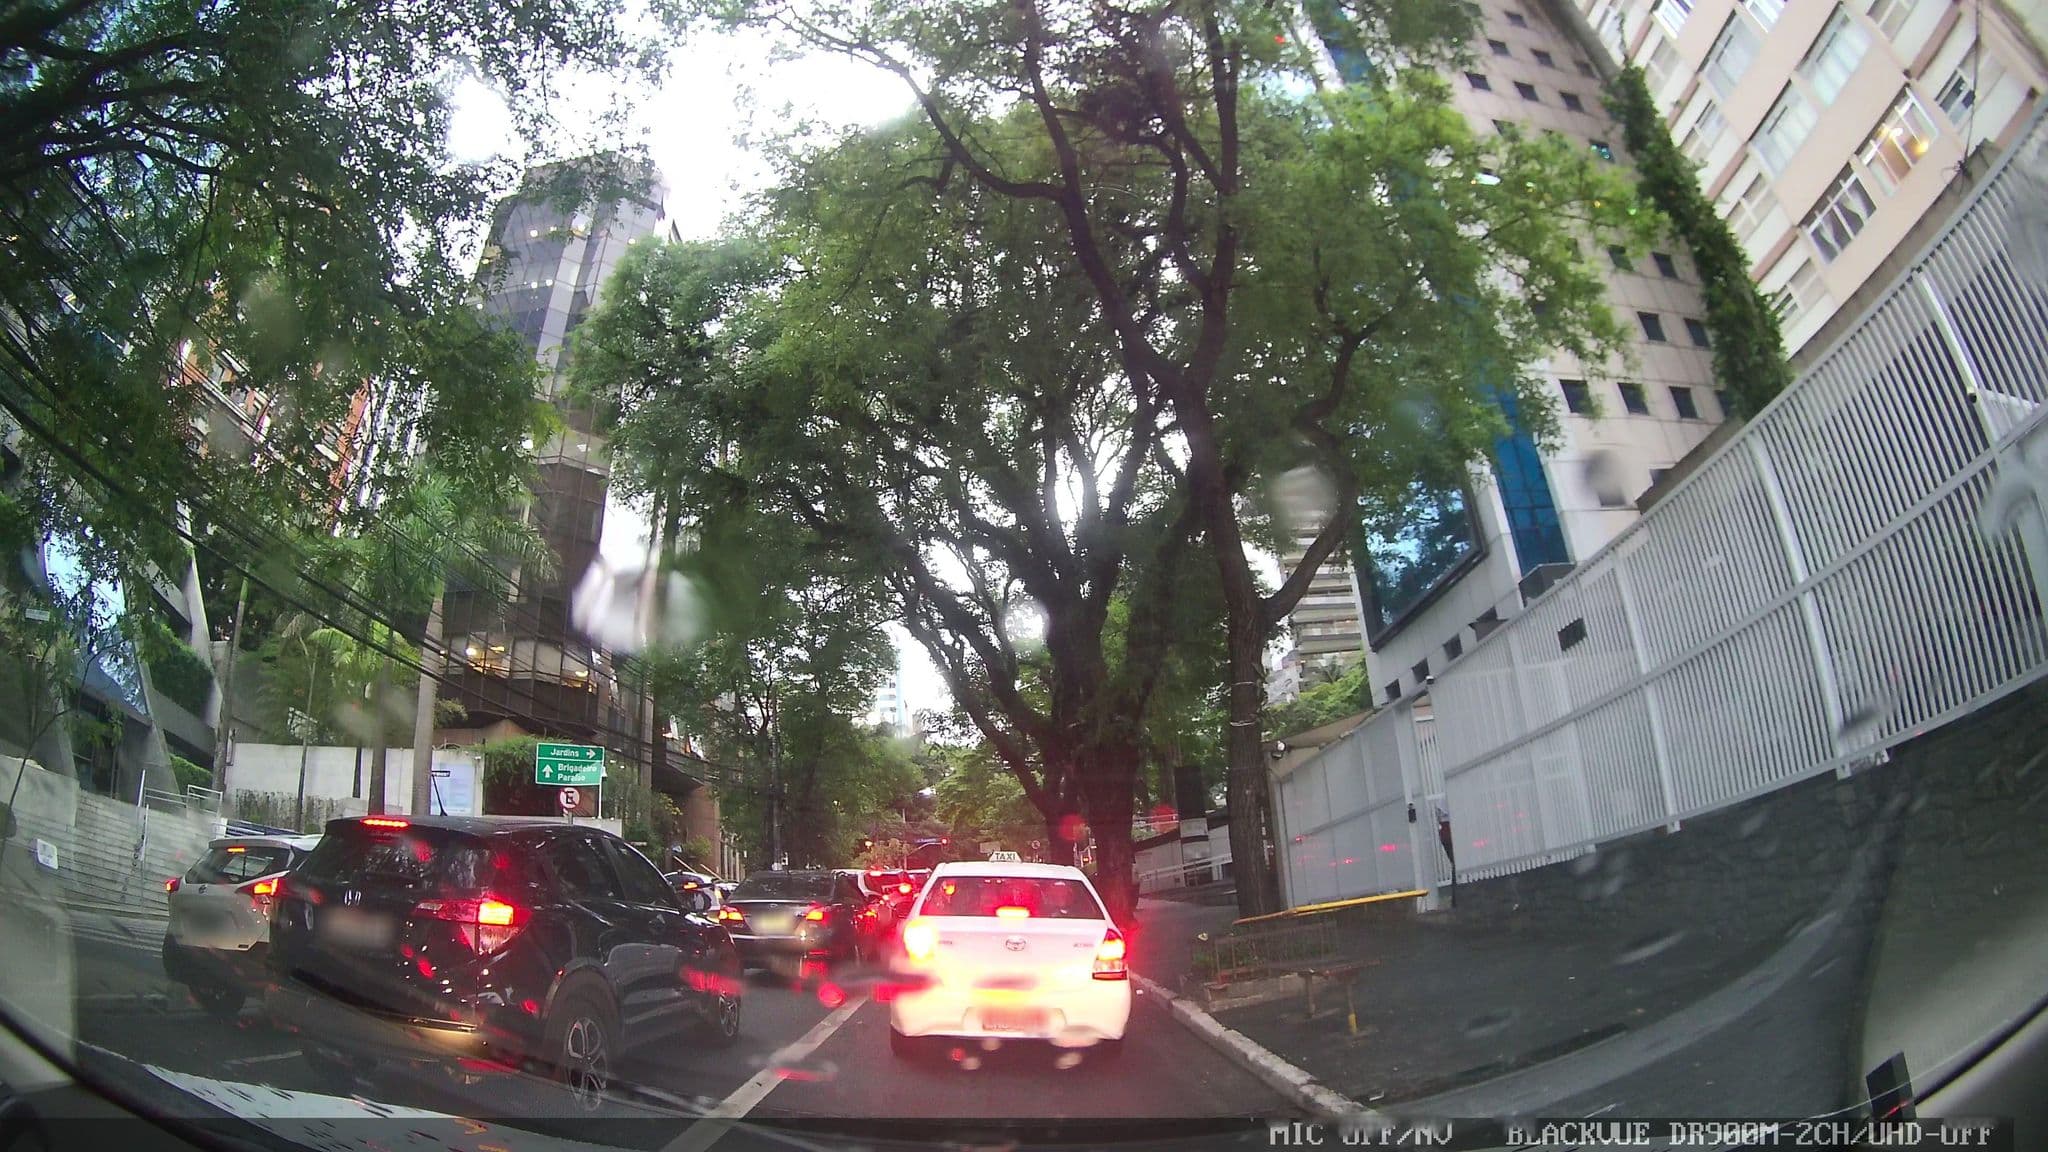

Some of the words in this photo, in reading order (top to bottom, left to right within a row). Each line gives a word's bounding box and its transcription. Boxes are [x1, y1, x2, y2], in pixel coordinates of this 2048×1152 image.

[550, 748, 579, 757] Jardins
[558, 763, 597, 773] Brigadeiro
[995, 852, 1015, 860] TAXI
